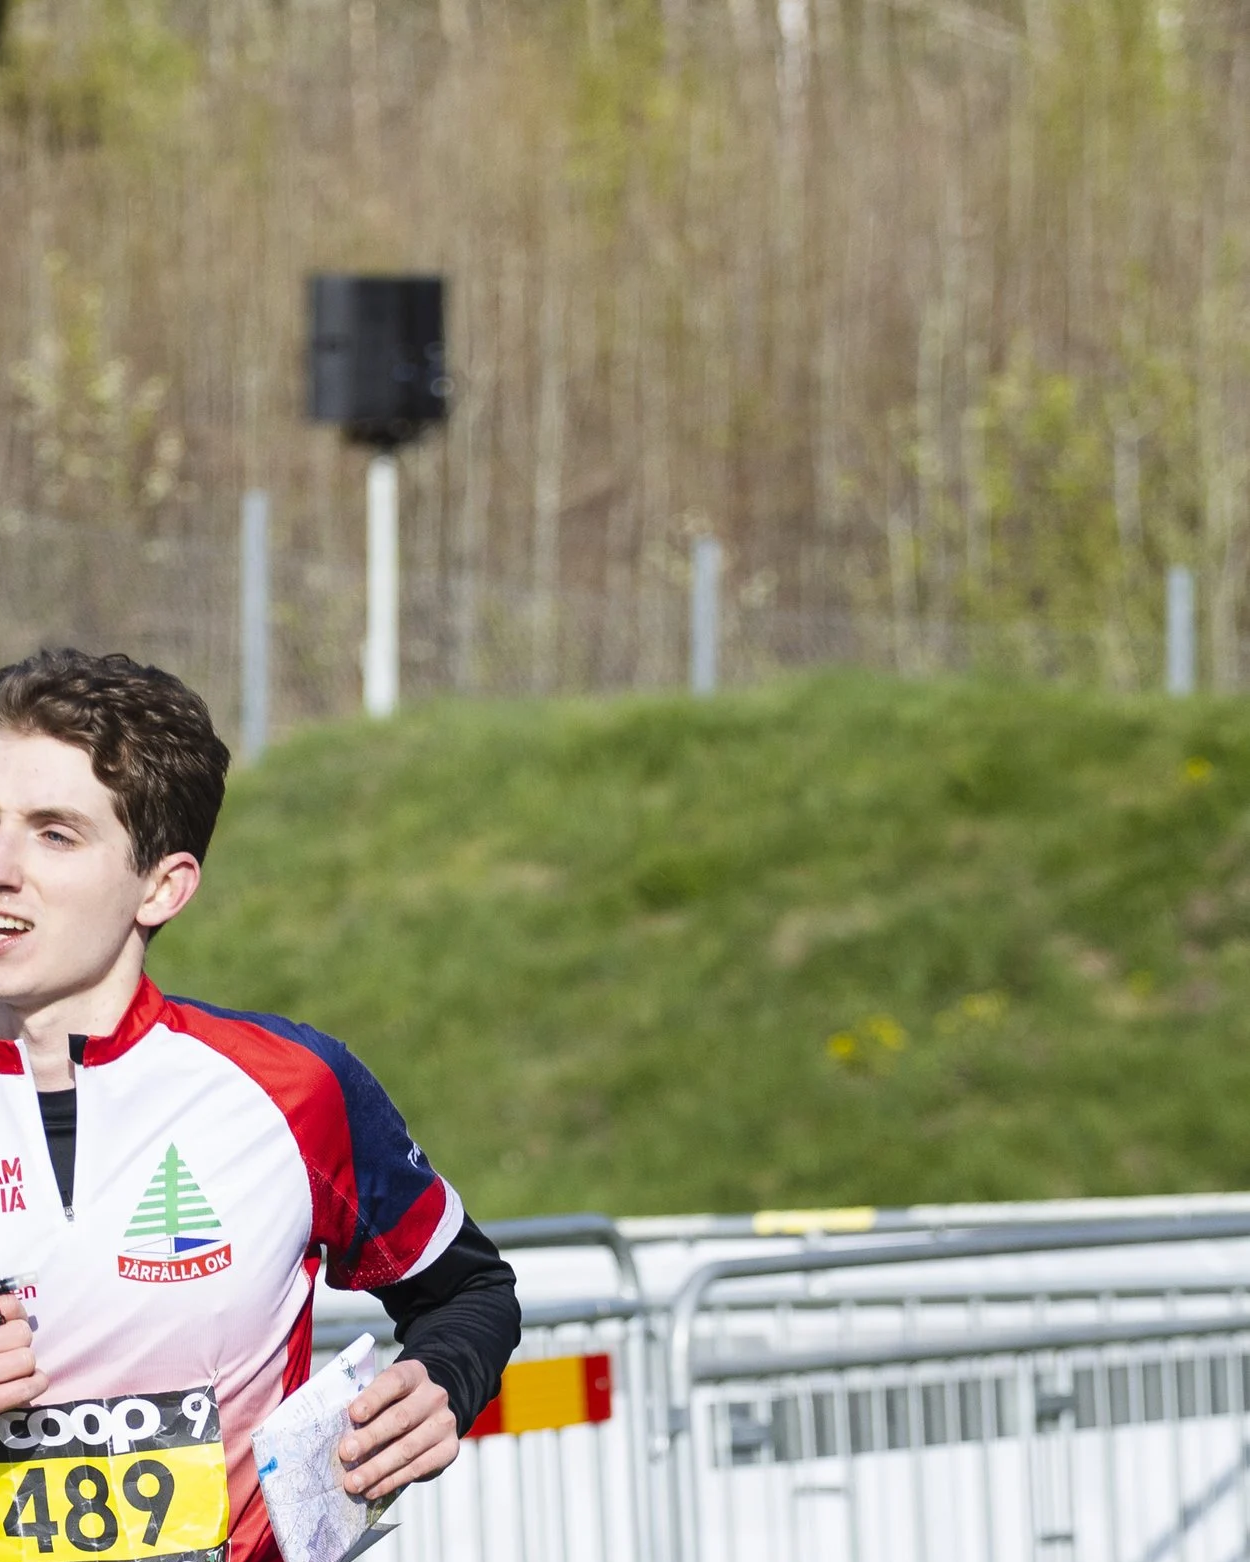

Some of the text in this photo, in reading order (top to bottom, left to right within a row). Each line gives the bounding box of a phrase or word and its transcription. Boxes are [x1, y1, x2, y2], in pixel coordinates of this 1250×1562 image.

[119, 1251, 230, 1281] JÄRFÄLLA OK
[181, 1393, 211, 1439] 9
[2, 1459, 175, 1554] 489
